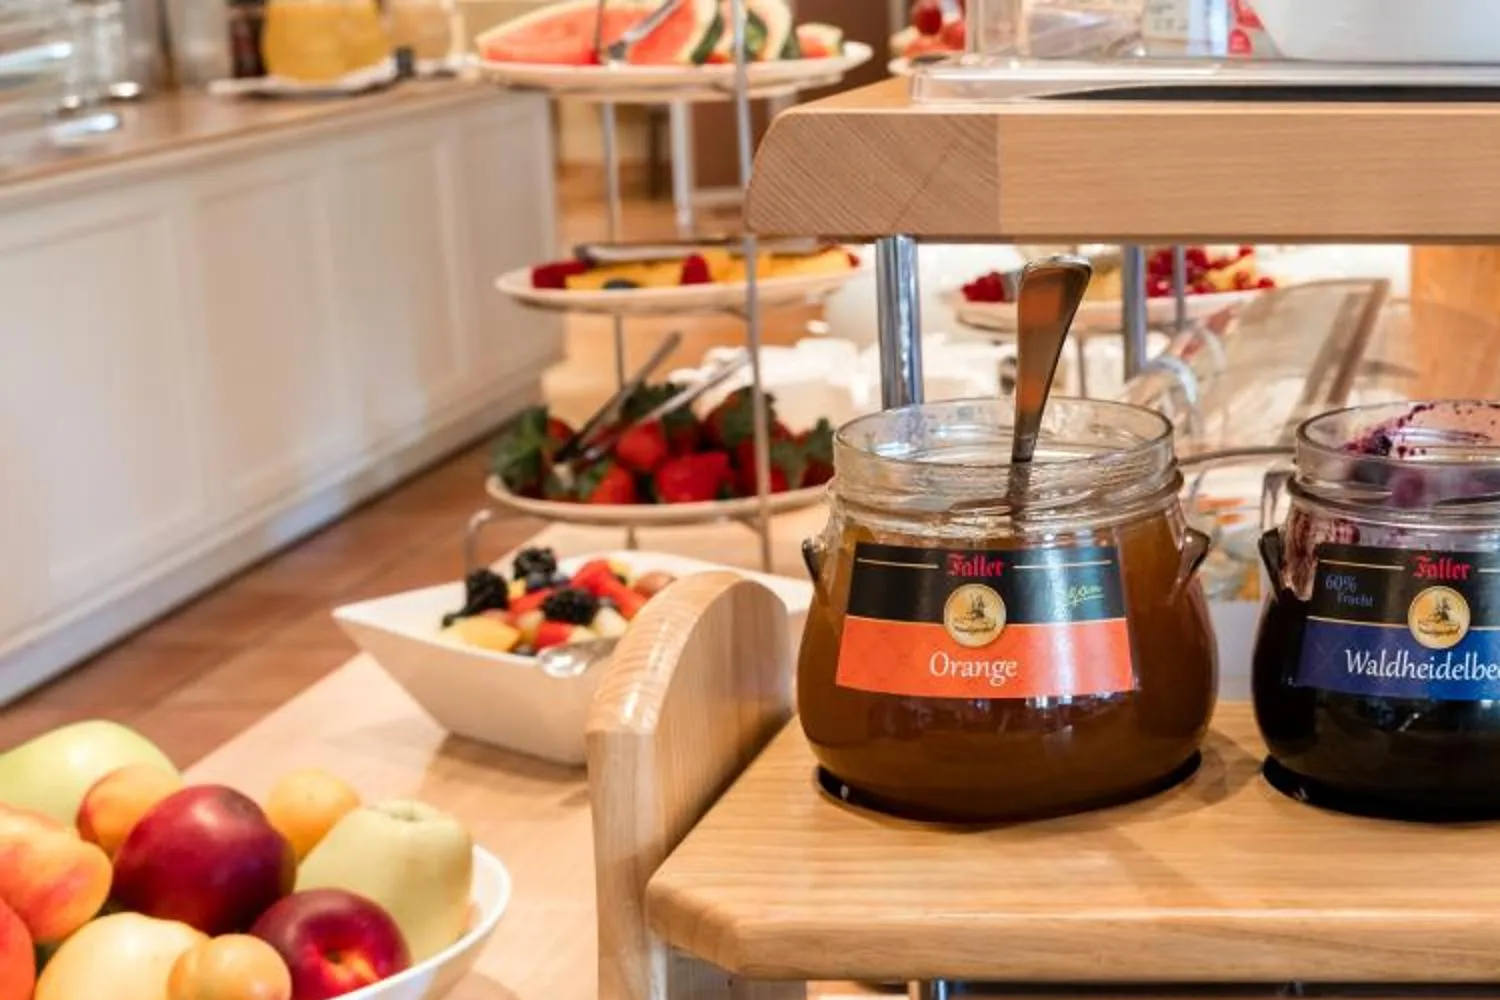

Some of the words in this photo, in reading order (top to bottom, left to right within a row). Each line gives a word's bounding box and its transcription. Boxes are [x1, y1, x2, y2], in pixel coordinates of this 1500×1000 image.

[946, 552, 1005, 577] Faller
[1413, 555, 1472, 582] Faller
[1324, 573, 1357, 594] 60%
[929, 651, 1018, 687] Orange
